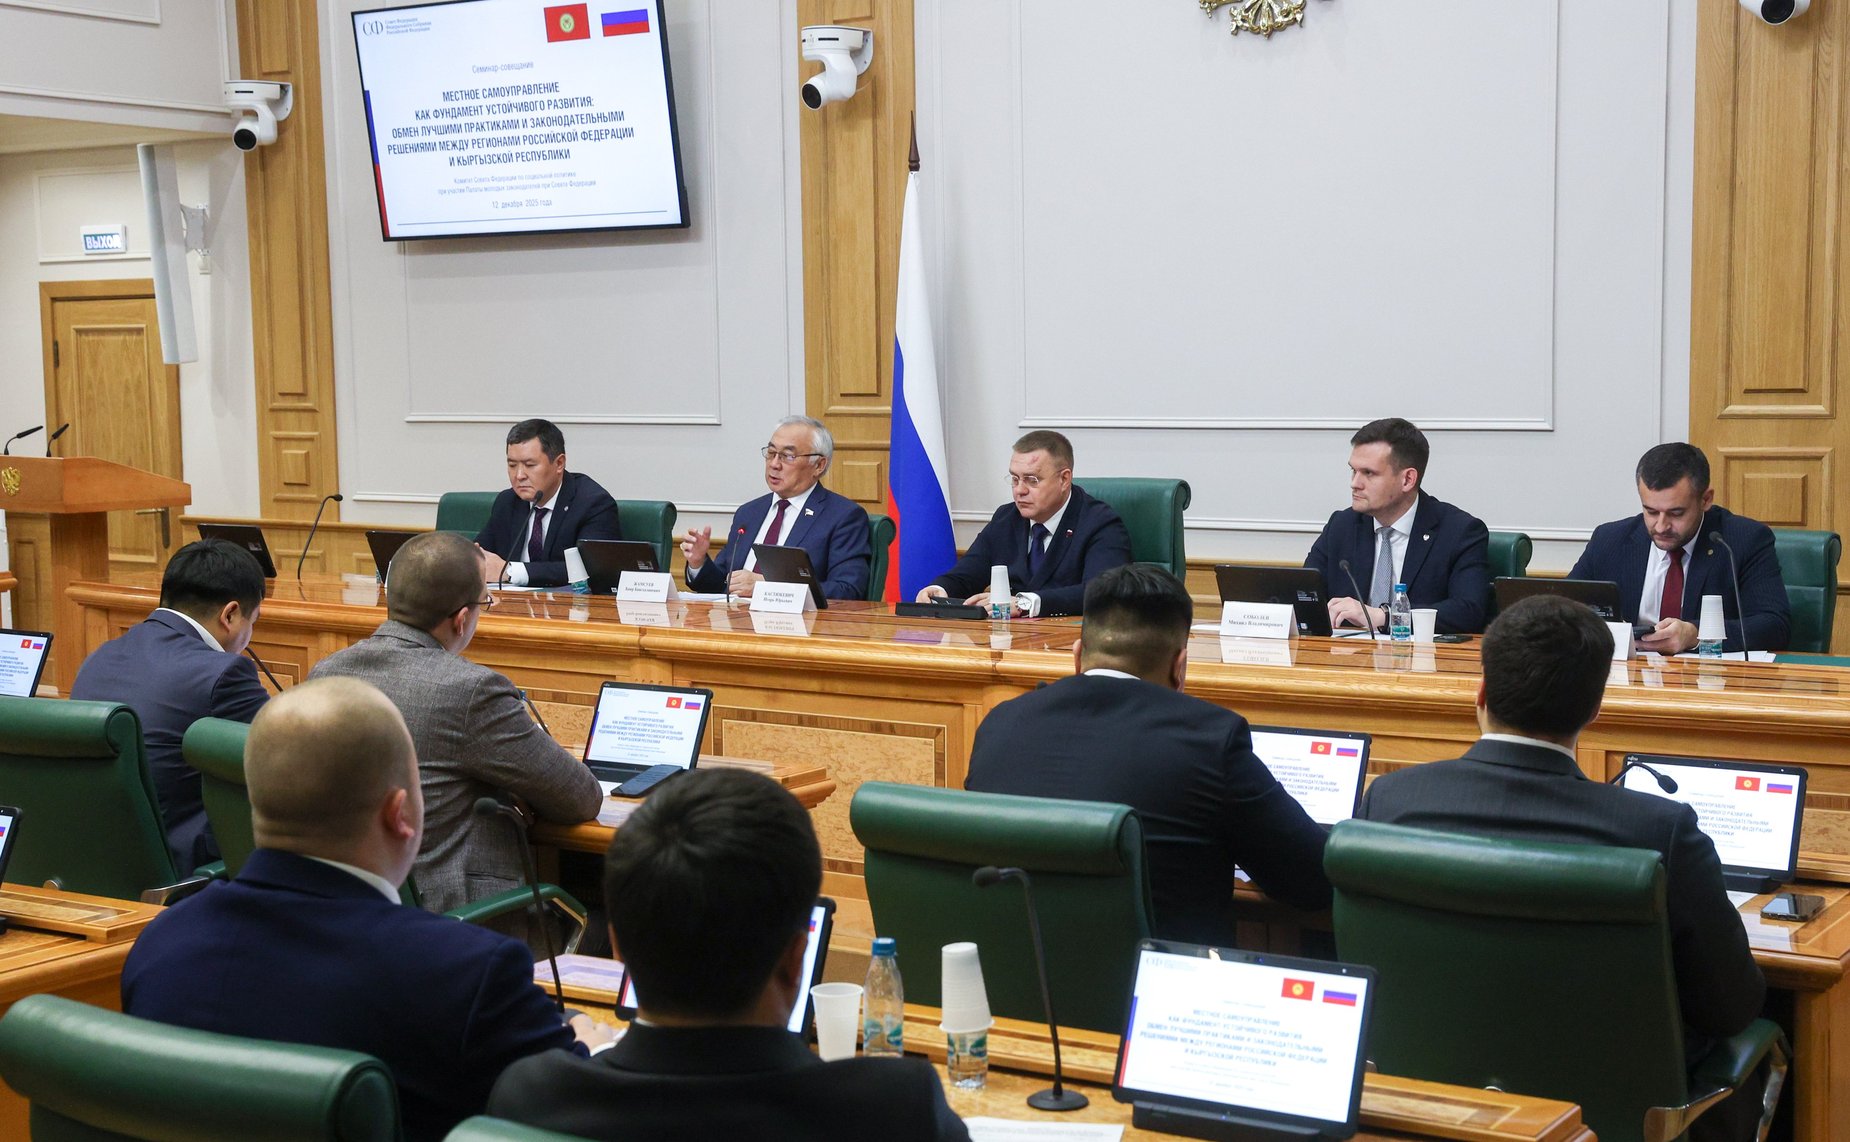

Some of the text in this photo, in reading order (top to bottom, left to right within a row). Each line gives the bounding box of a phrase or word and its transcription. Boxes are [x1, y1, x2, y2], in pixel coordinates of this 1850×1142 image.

[362, 20, 384, 36] СФ
[472, 62, 534, 74] Семинар-совещание
[442, 82, 560, 102] МЕСТНОЕ САМОУПРАВЛЕНИЕ
[414, 96, 594, 120] КАК ФУНДАМЕНТ УСТОЙЧИВОГО РАЗВИТИЯ:
[392, 110, 625, 138] ОБМЕН ЛУЧШИМИ ПРАКТИКАМИ И ЗАКОНОДАТЕЛЬНЫМИ
[388, 127, 634, 154] РЕШЕНИЯМИ МЕЖДУ РЕГИОНАМИ РОССИЙСКОЙ ФЕДЕРАЦИИ
[448, 148, 570, 166] И КЫРГЫЗСКОЙ РЕСПУБЛИКИ
[492, 200, 499, 208] 12
[501, 200, 523, 209] декабря
[526, 198, 539, 208] 2025
[86, 234, 122, 248] ВЫХОД
